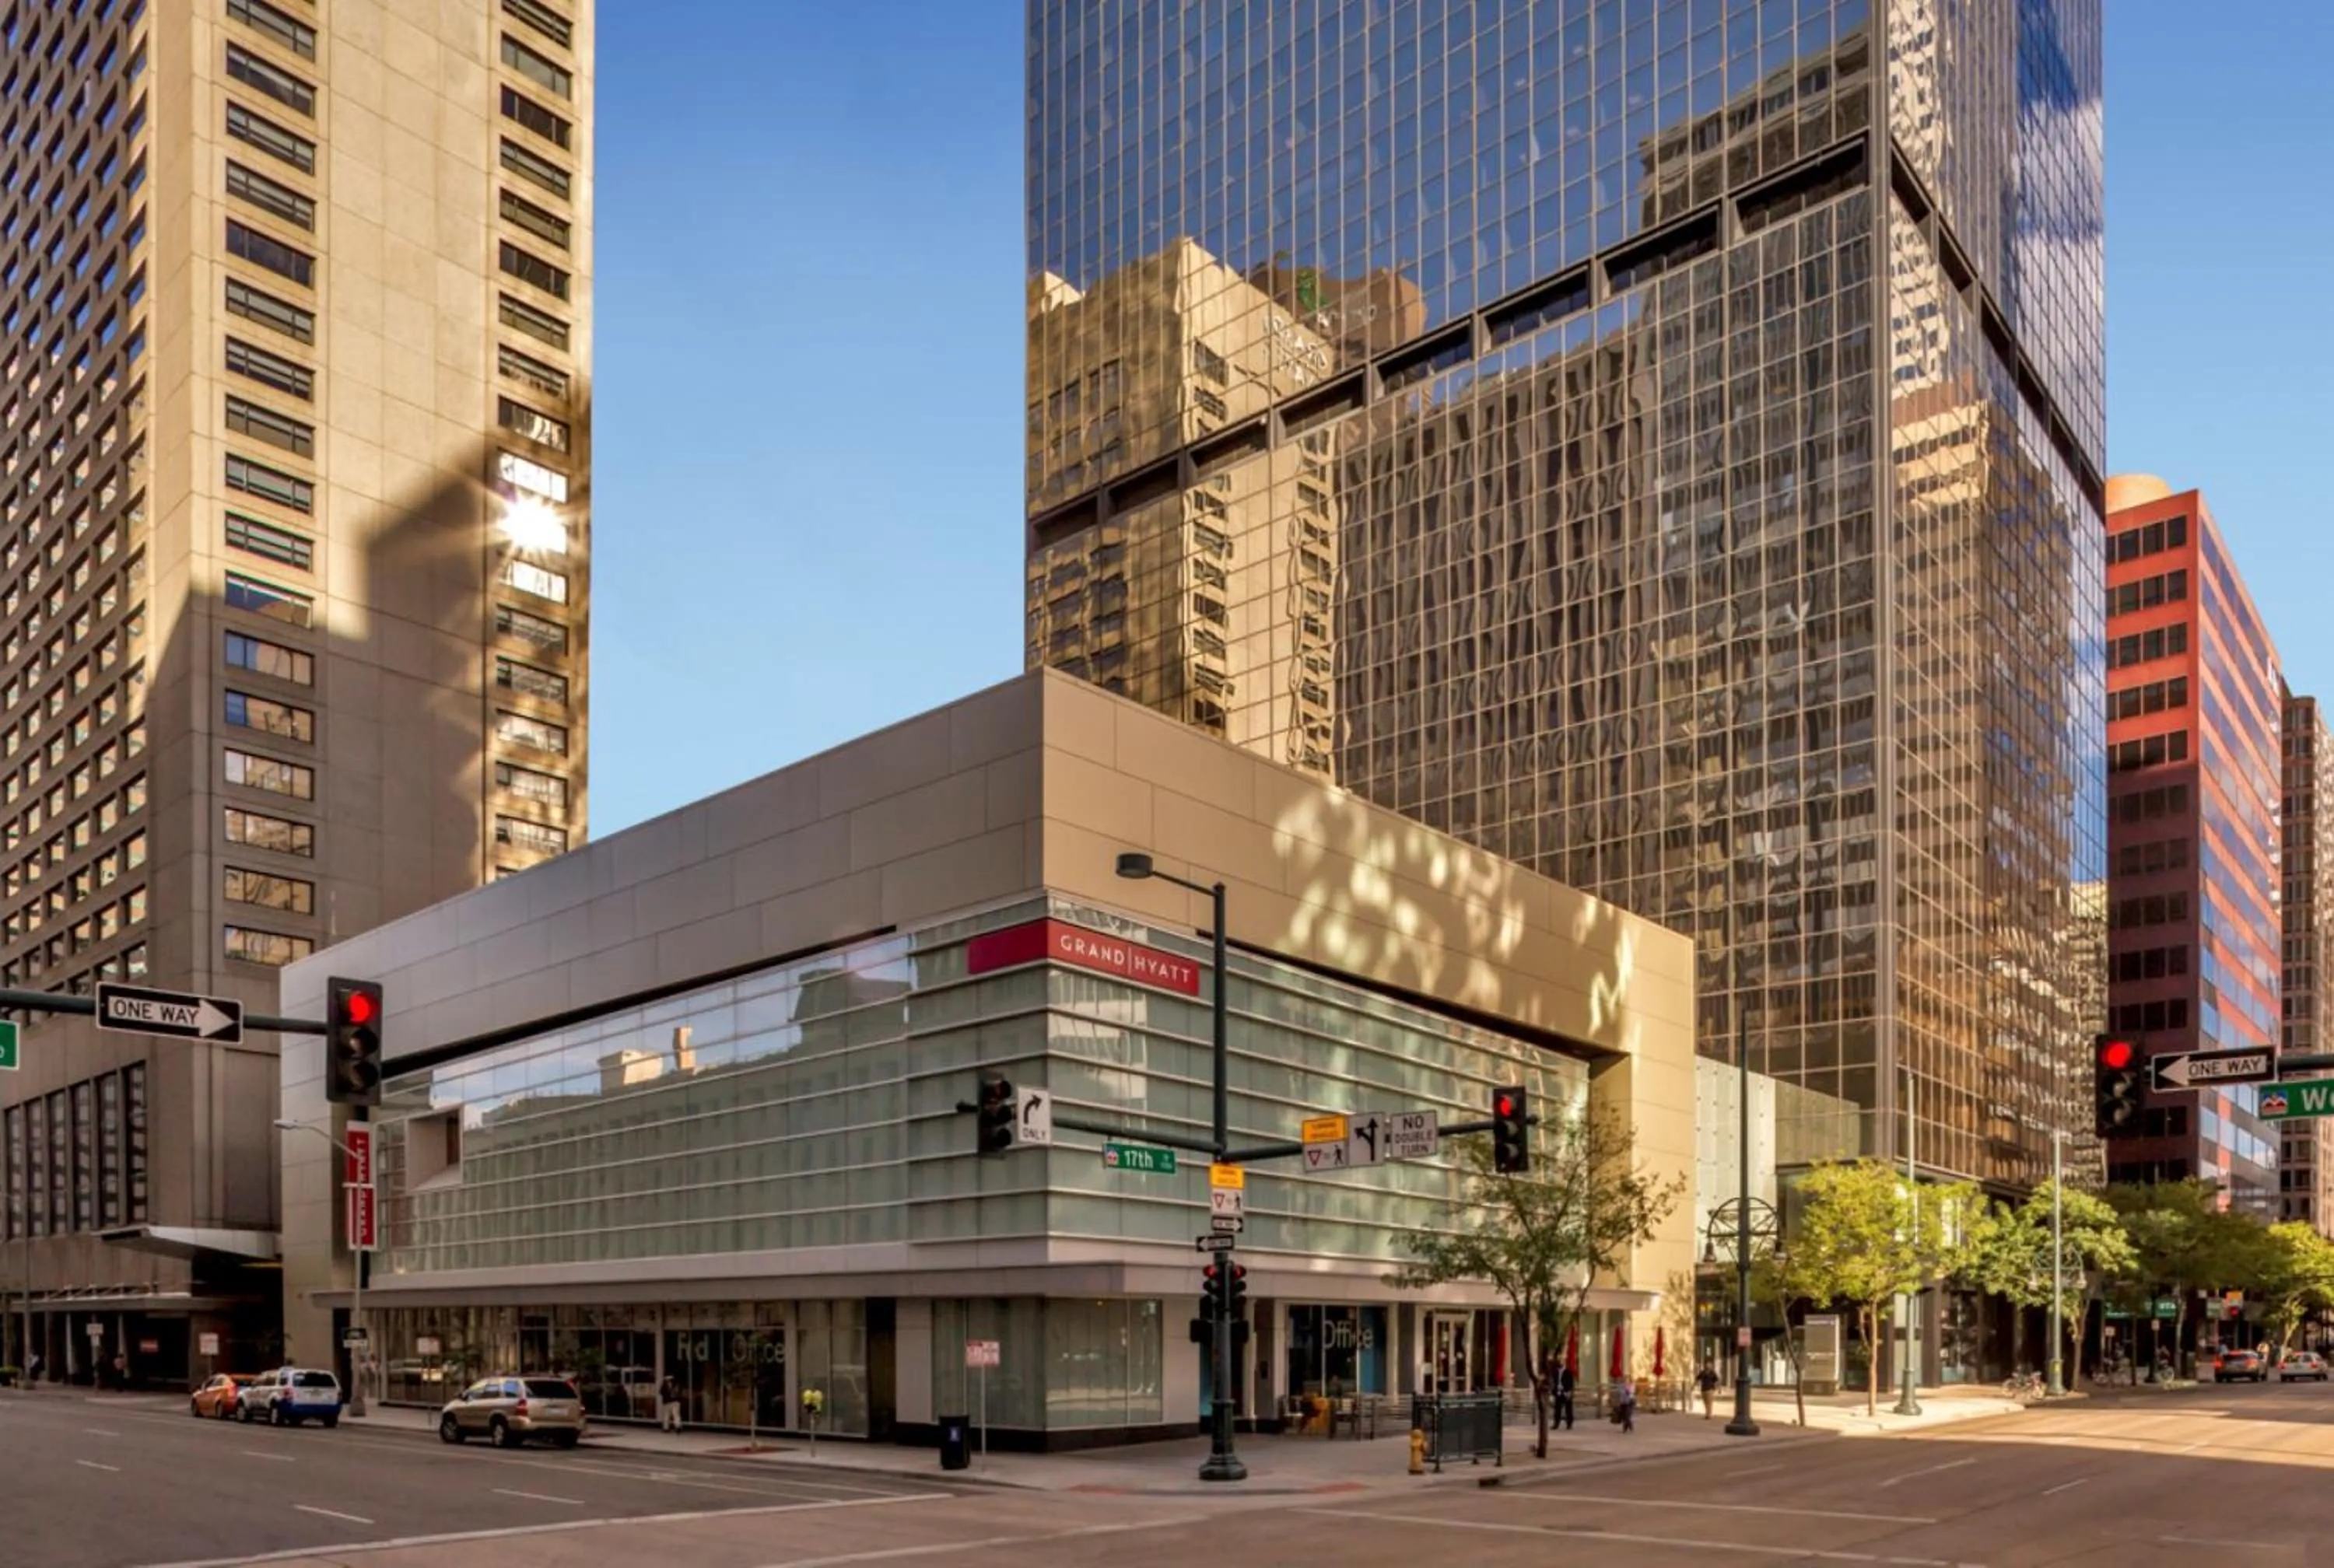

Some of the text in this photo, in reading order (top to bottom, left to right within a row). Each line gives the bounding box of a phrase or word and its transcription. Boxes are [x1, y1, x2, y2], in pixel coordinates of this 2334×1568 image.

[1060, 935, 1190, 983] GRAND HYATT
[114, 999, 198, 1024] ONE WAY
[2189, 1057, 2262, 1076] ONE WAY
[1403, 1115, 1424, 1129] NO
[1022, 1127, 1046, 1140] ONLY
[1395, 1129, 1432, 1143] DOUBLE
[1401, 1143, 1428, 1154] TURN
[1124, 1150, 1154, 1168] 17th
